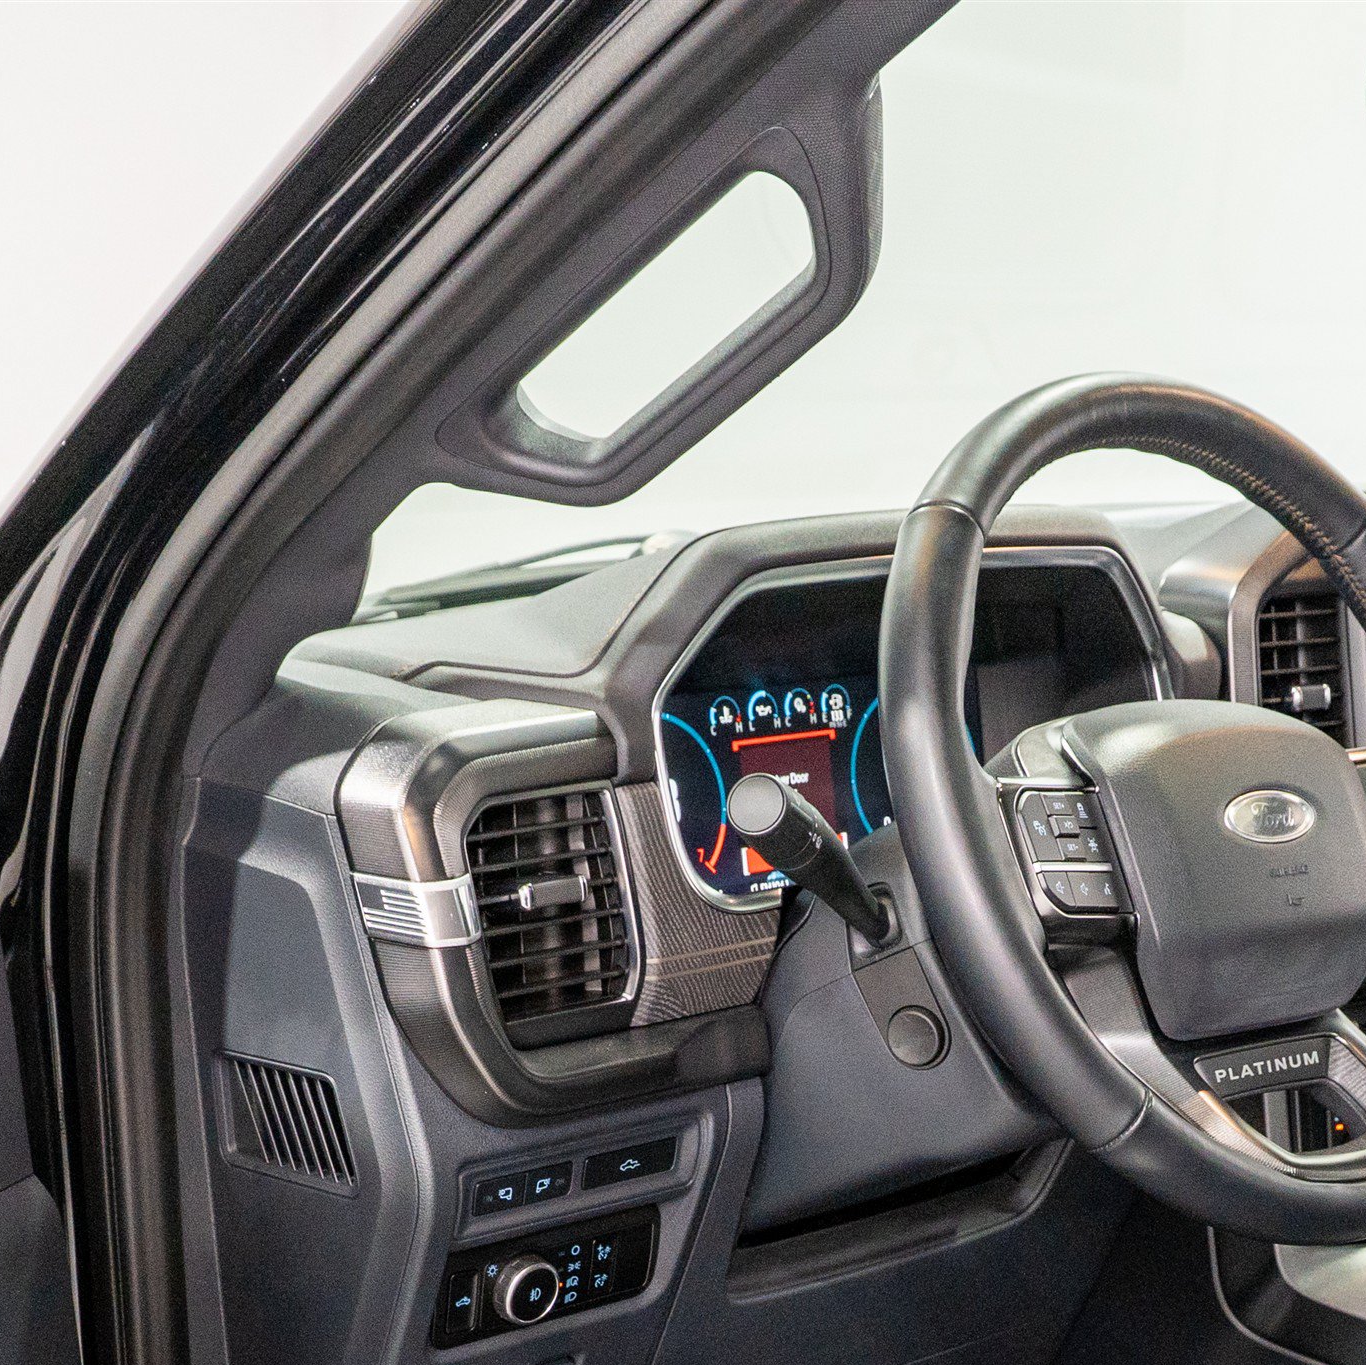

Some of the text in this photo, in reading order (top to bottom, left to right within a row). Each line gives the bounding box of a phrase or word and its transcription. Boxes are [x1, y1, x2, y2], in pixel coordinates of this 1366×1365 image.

[749, 721, 755, 732] L
[1250, 801, 1296, 829] Ford
[1215, 1051, 1320, 1083] PLATINUM
